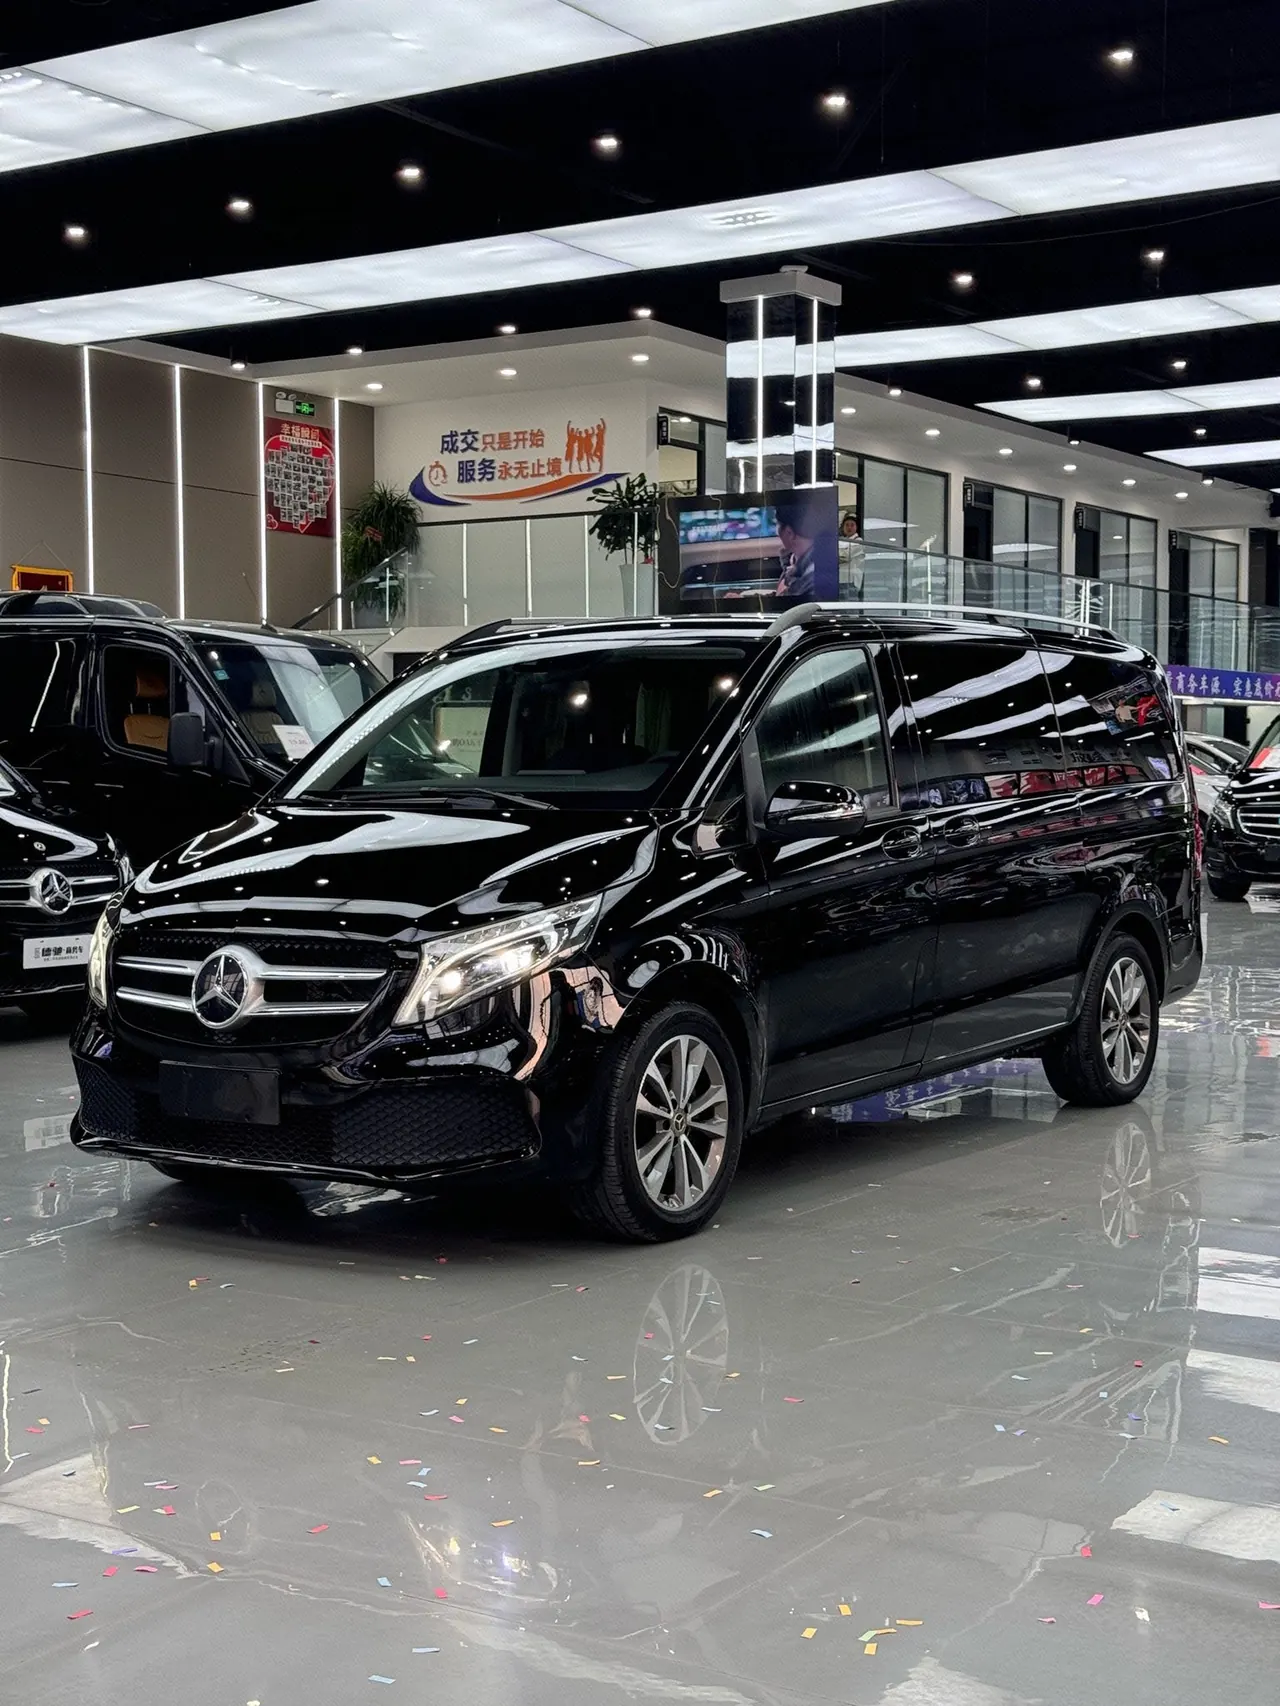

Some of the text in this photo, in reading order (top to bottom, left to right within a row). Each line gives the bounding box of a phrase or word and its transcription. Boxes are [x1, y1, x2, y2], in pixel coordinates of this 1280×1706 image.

[440, 428, 545, 454] 成交只是开始
[457, 456, 562, 483] 服务永无止境
